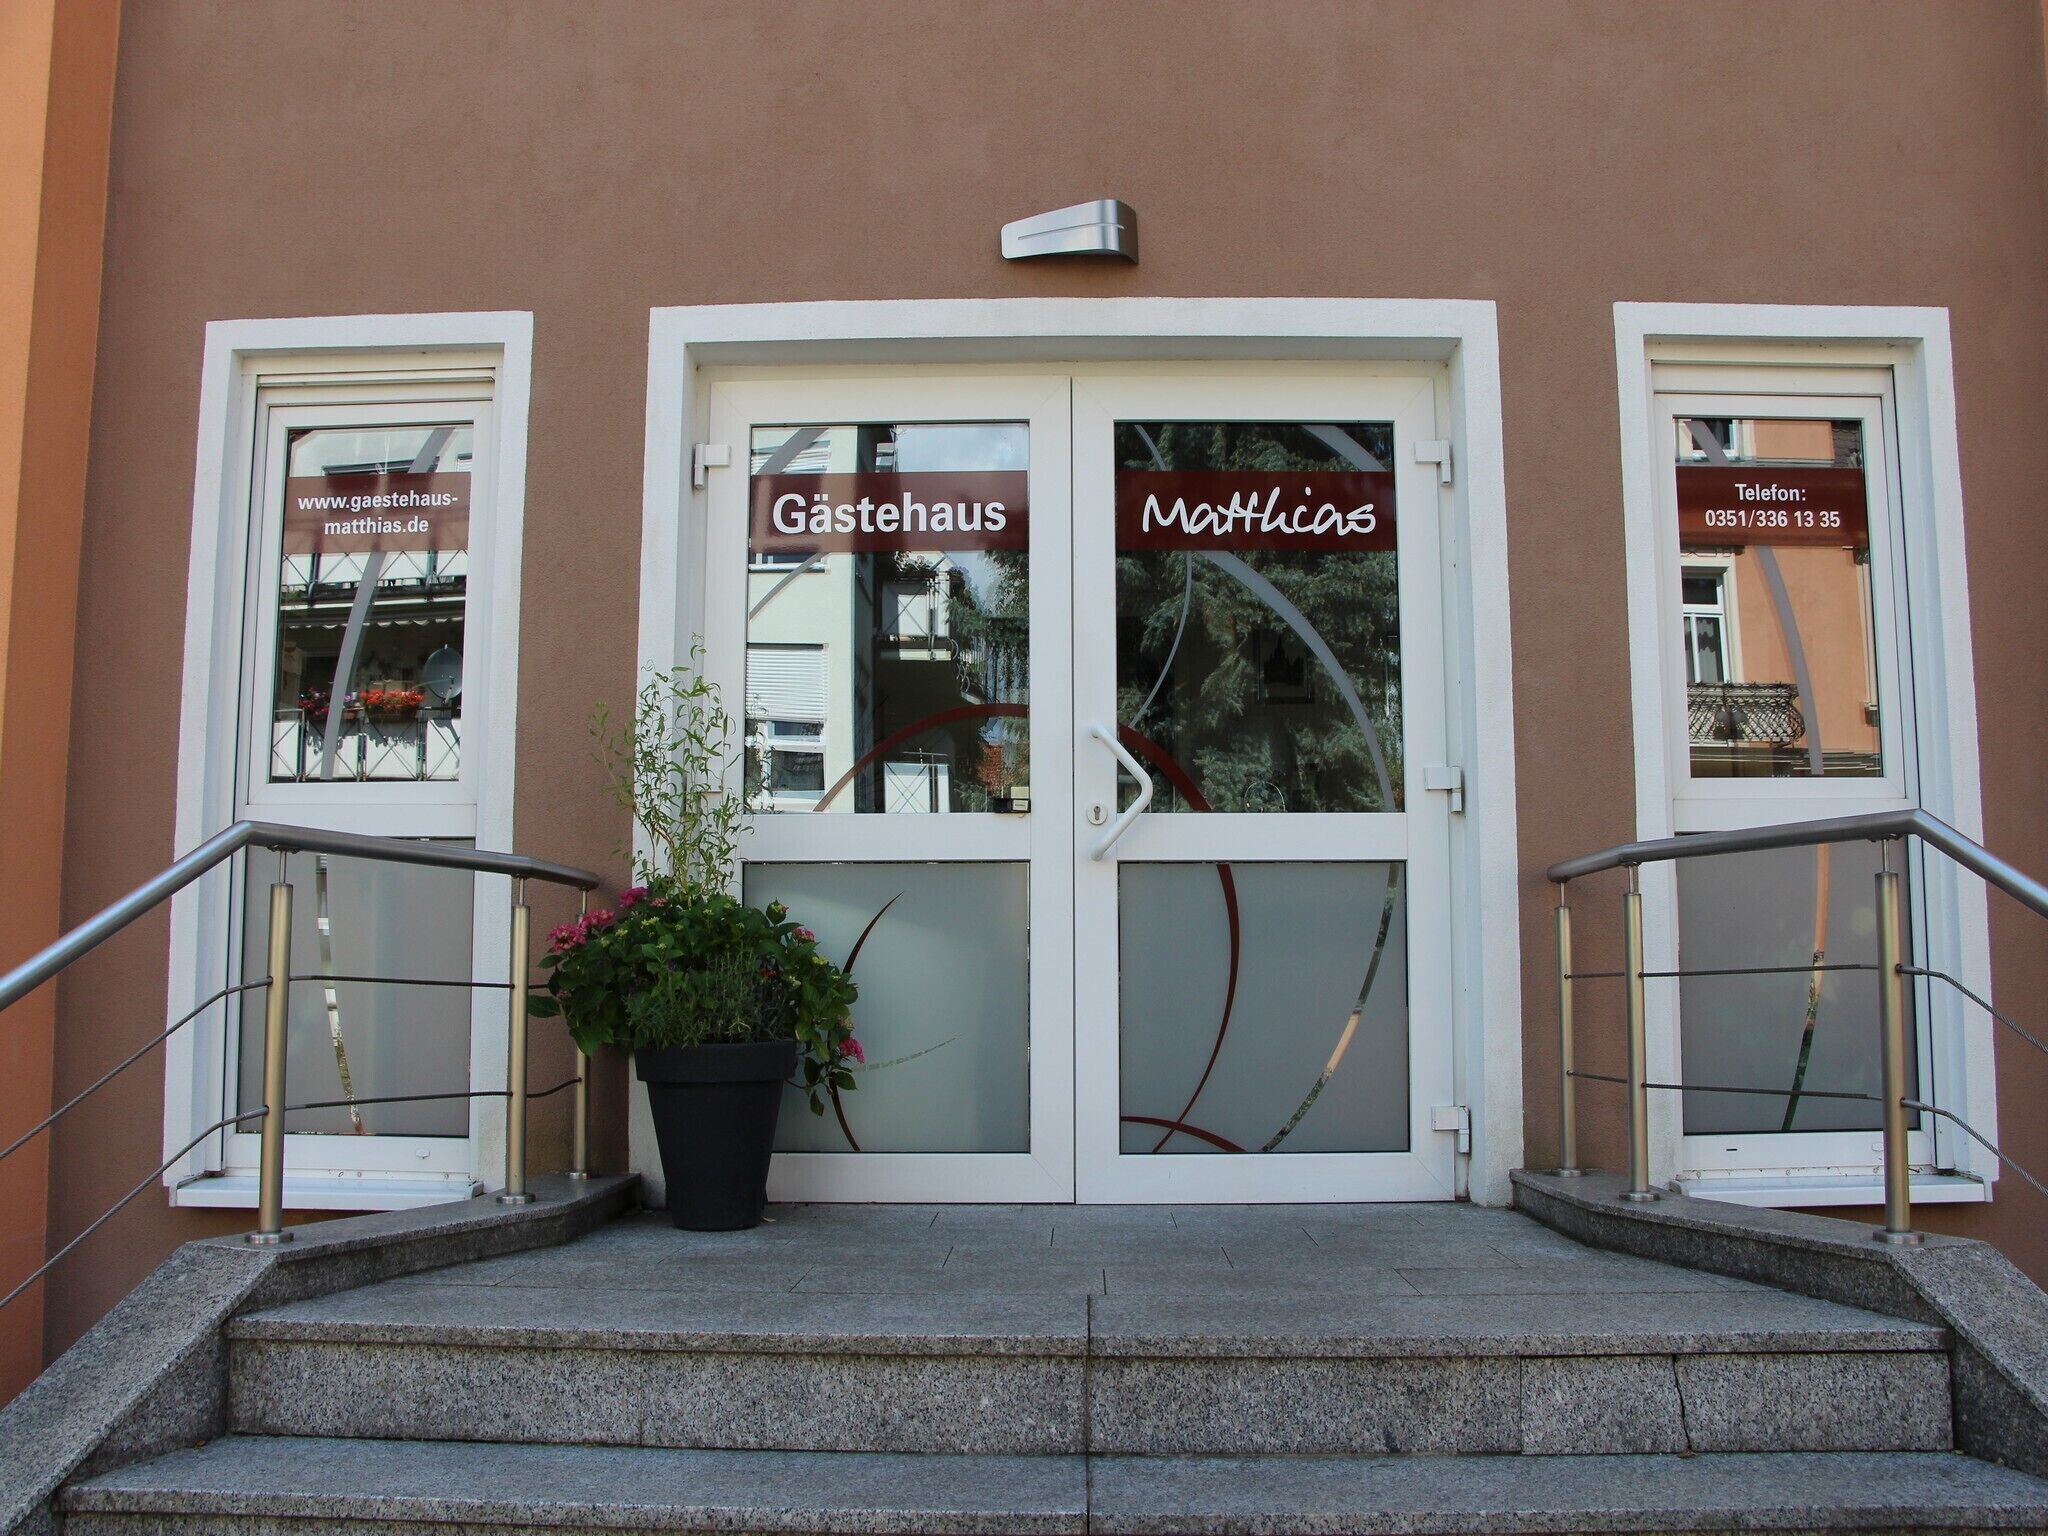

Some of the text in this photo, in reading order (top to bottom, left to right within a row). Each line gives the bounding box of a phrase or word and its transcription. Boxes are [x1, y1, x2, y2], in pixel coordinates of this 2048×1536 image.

[298, 490, 458, 512] www.gaestehaus-
[1735, 483, 1806, 502] Telefon:
[772, 486, 1376, 536] Gästehaus Matthias
[1705, 509, 1840, 528] 0351/336 13 35
[324, 516, 429, 535] matthias.de
